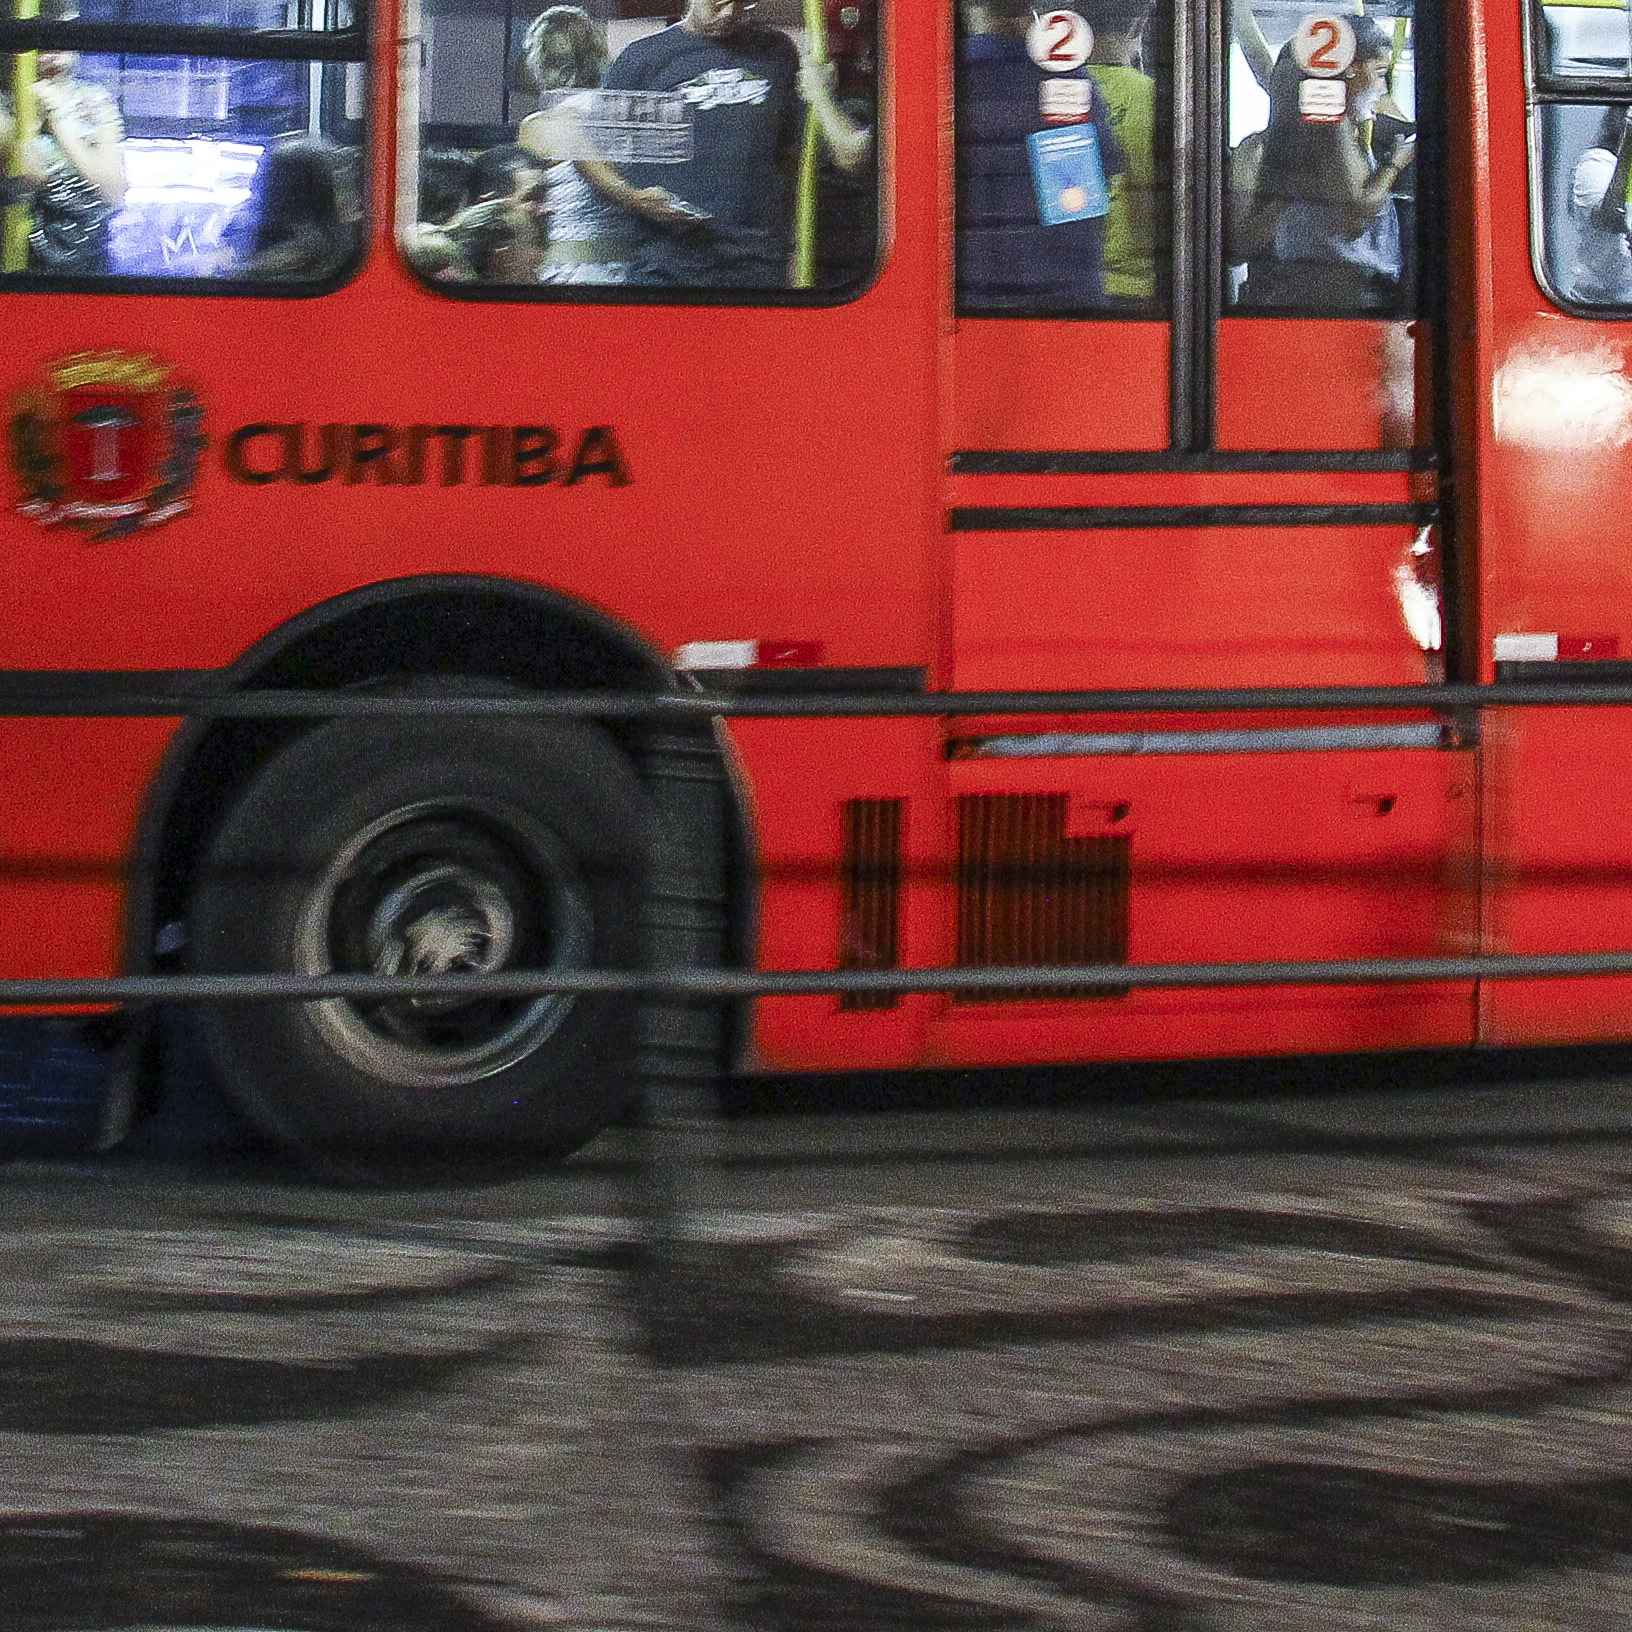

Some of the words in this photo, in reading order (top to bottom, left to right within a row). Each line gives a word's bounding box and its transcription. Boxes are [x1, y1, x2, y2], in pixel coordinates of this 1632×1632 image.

[1047, 14, 1075, 62] 2
[1308, 20, 1342, 69] 2
[225, 422, 634, 488] CURITIBA
